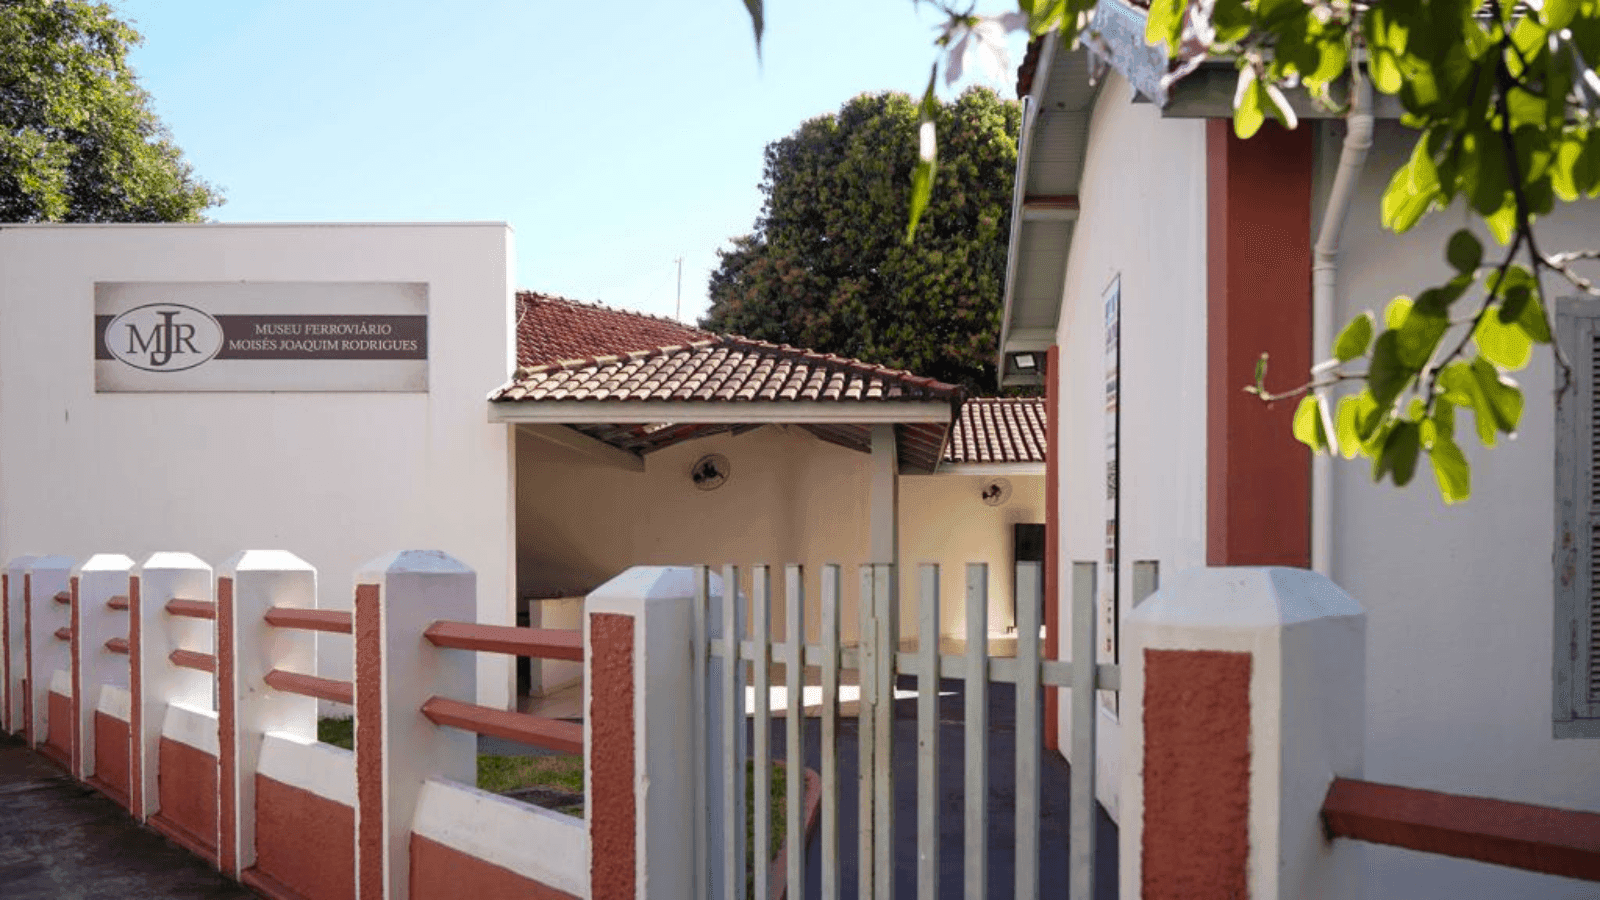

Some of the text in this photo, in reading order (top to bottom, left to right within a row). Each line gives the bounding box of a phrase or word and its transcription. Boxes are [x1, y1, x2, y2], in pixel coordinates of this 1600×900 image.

[254, 321, 392, 336] MUSEU FERROVIÁRIO
[228, 338, 418, 354] MOISÉS JOAQUIM RODRIGUES
